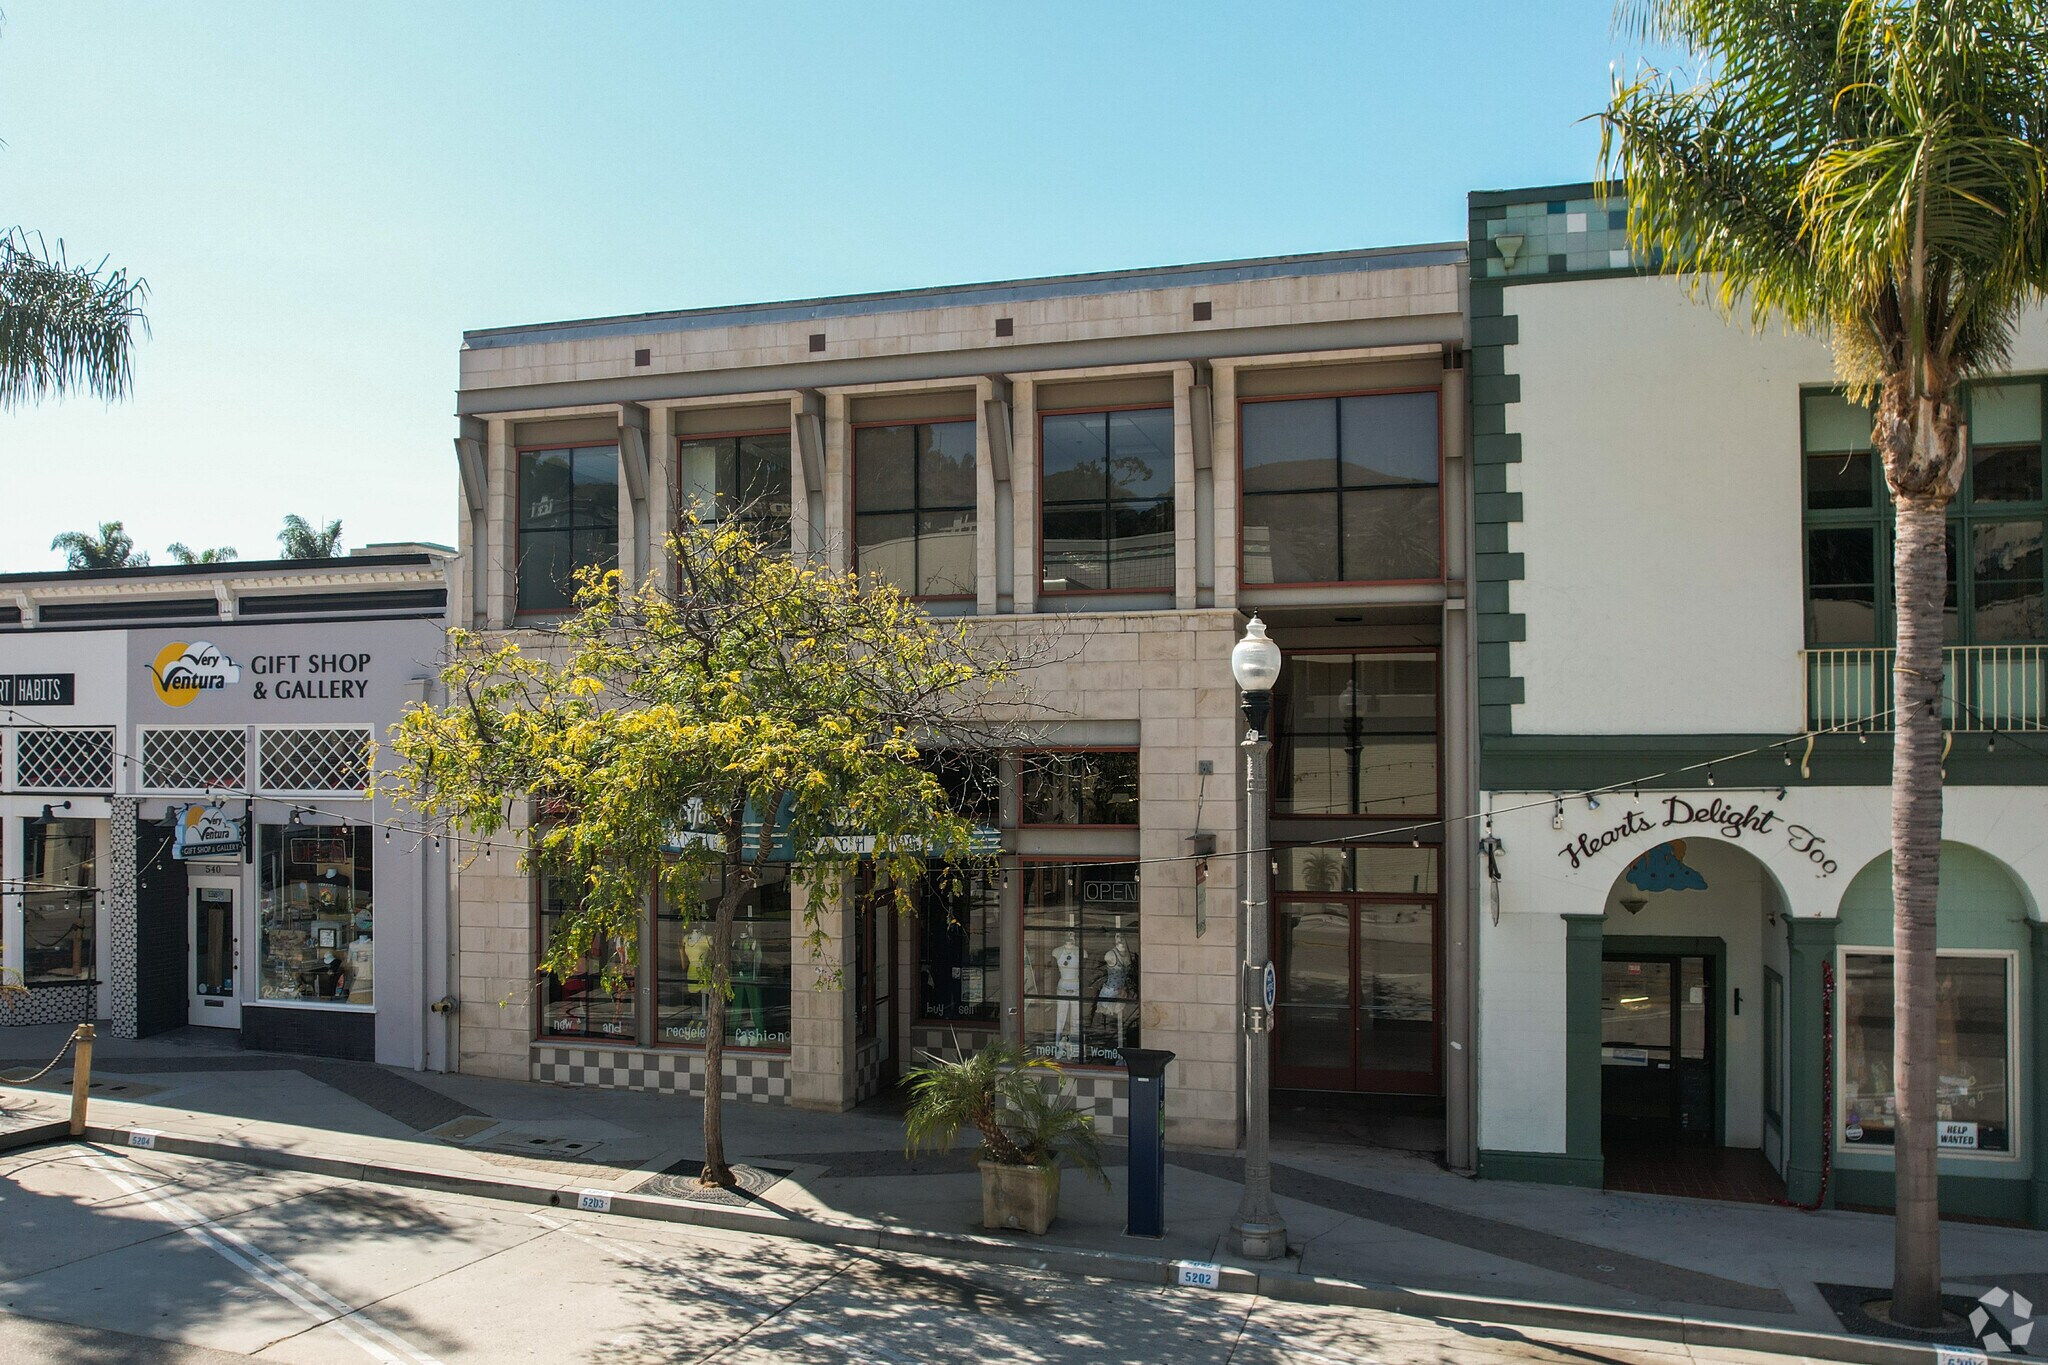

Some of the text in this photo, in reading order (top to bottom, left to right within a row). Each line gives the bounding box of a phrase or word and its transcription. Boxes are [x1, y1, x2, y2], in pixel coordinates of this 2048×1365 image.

[178, 646, 220, 668] Very
[251, 653, 371, 675] GIFT SHOP
[144, 664, 225, 693] Ventura
[18, 678, 61, 701] HABITS
[253, 680, 368, 700] & GALLERY
[192, 825, 230, 842] Ventura
[1558, 795, 1838, 875] Hearts Delight Too
[197, 845, 213, 854] SHOP
[216, 842, 240, 852] GALLERY
[205, 865, 221, 874] 540
[1086, 883, 1137, 901] OPEN
[926, 1002, 974, 1017] buy sell
[553, 1018, 573, 1030] new
[602, 1020, 622, 1034] and
[735, 1027, 785, 1043] fashion
[1946, 1125, 1968, 1134] HELP
[132, 1136, 151, 1146] 5204
[1940, 1135, 1974, 1145] WANTED
[582, 1197, 604, 1209] 5203
[1185, 1271, 1211, 1285] 5202
